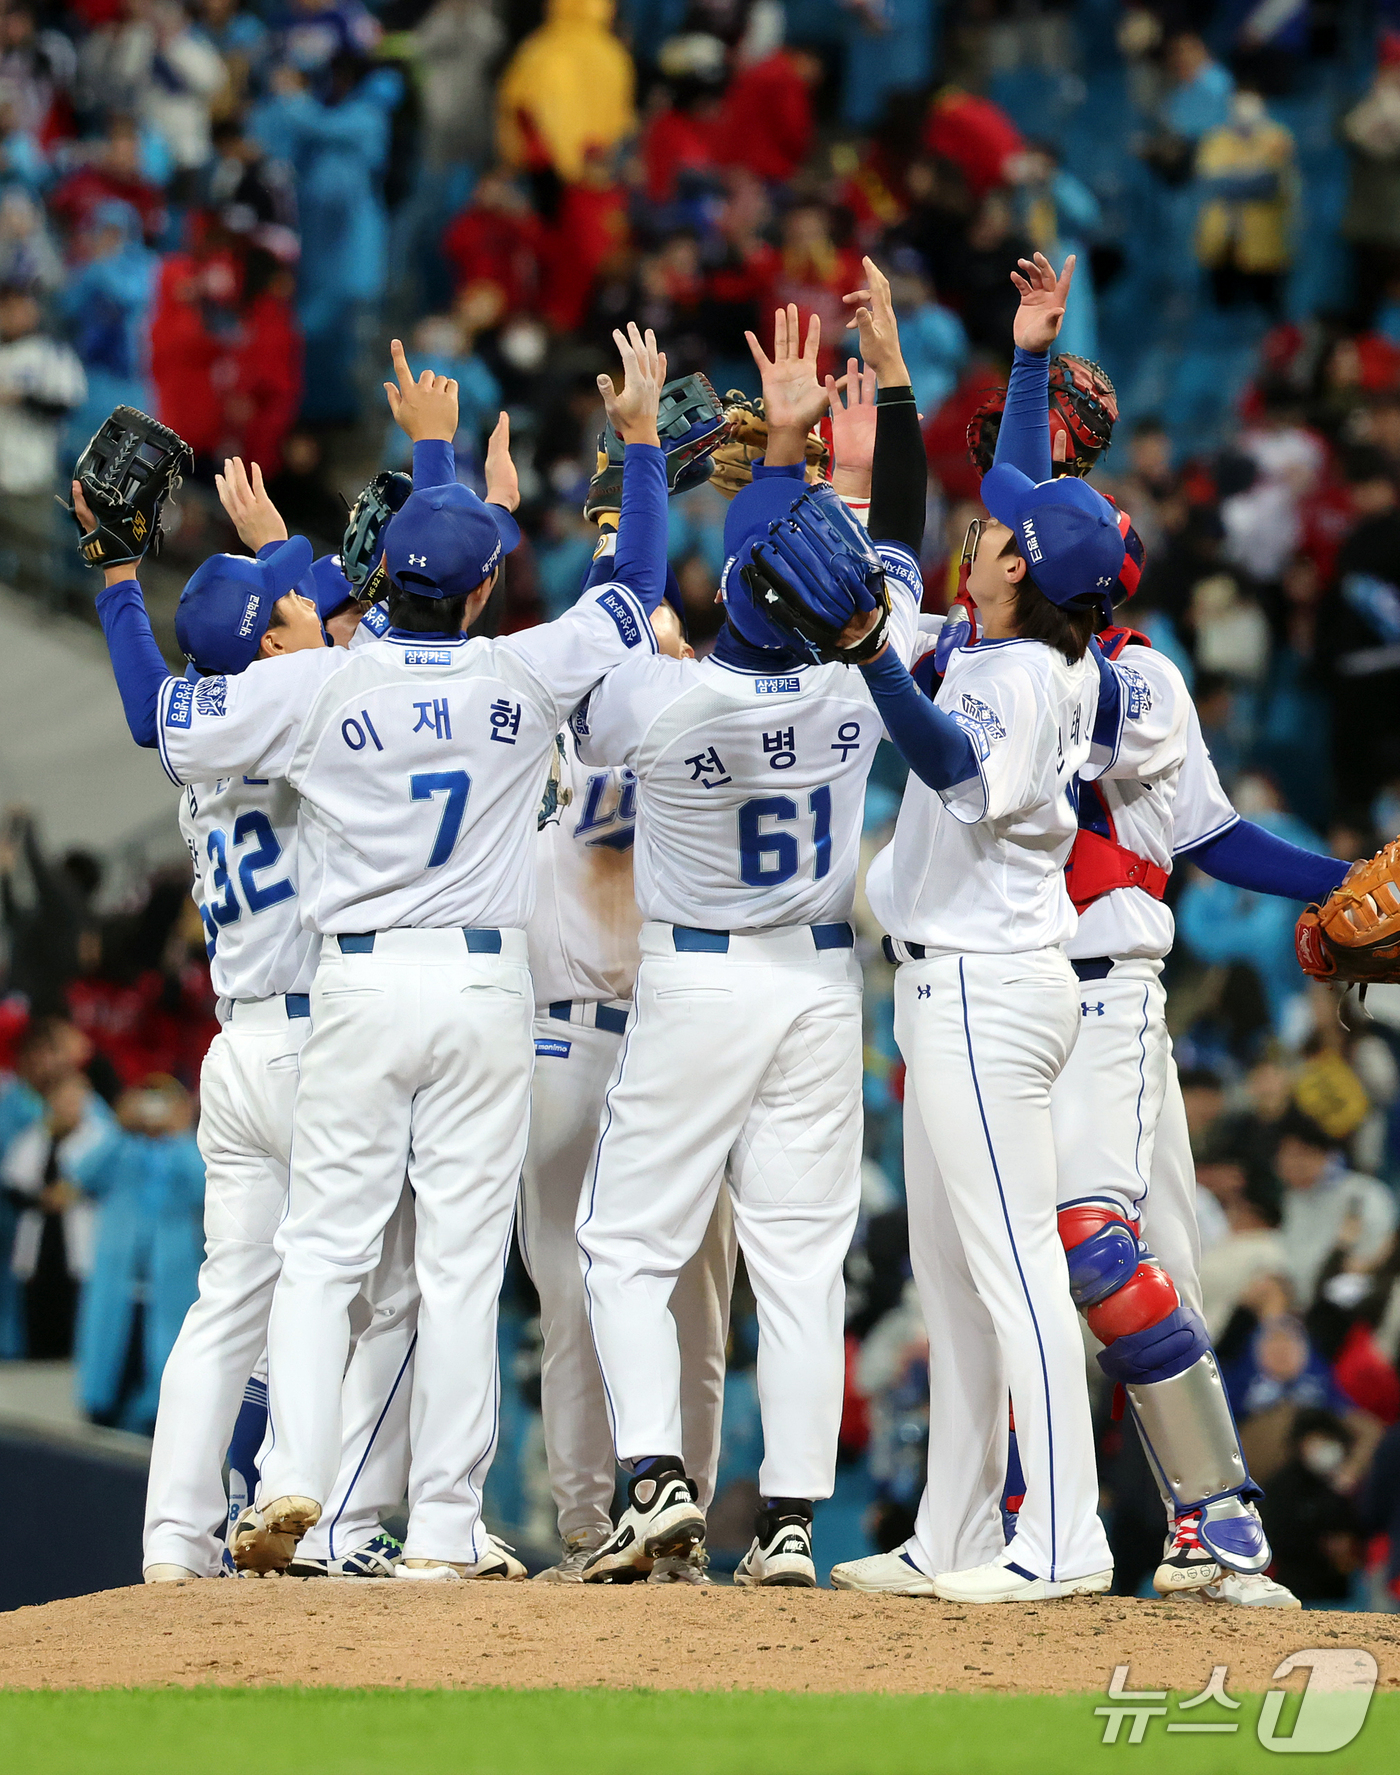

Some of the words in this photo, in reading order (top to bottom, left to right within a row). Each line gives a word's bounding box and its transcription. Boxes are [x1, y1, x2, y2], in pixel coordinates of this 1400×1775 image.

[239, 594, 260, 637] 대구대학교
[603, 594, 637, 642] 삼성화재
[406, 652, 450, 664] 삼성카드
[757, 679, 799, 693] 삼성카드
[408, 768, 473, 870] 7
[736, 782, 832, 888] 61
[206, 807, 299, 929] 32
[783, 1539, 805, 1553] NIKE
